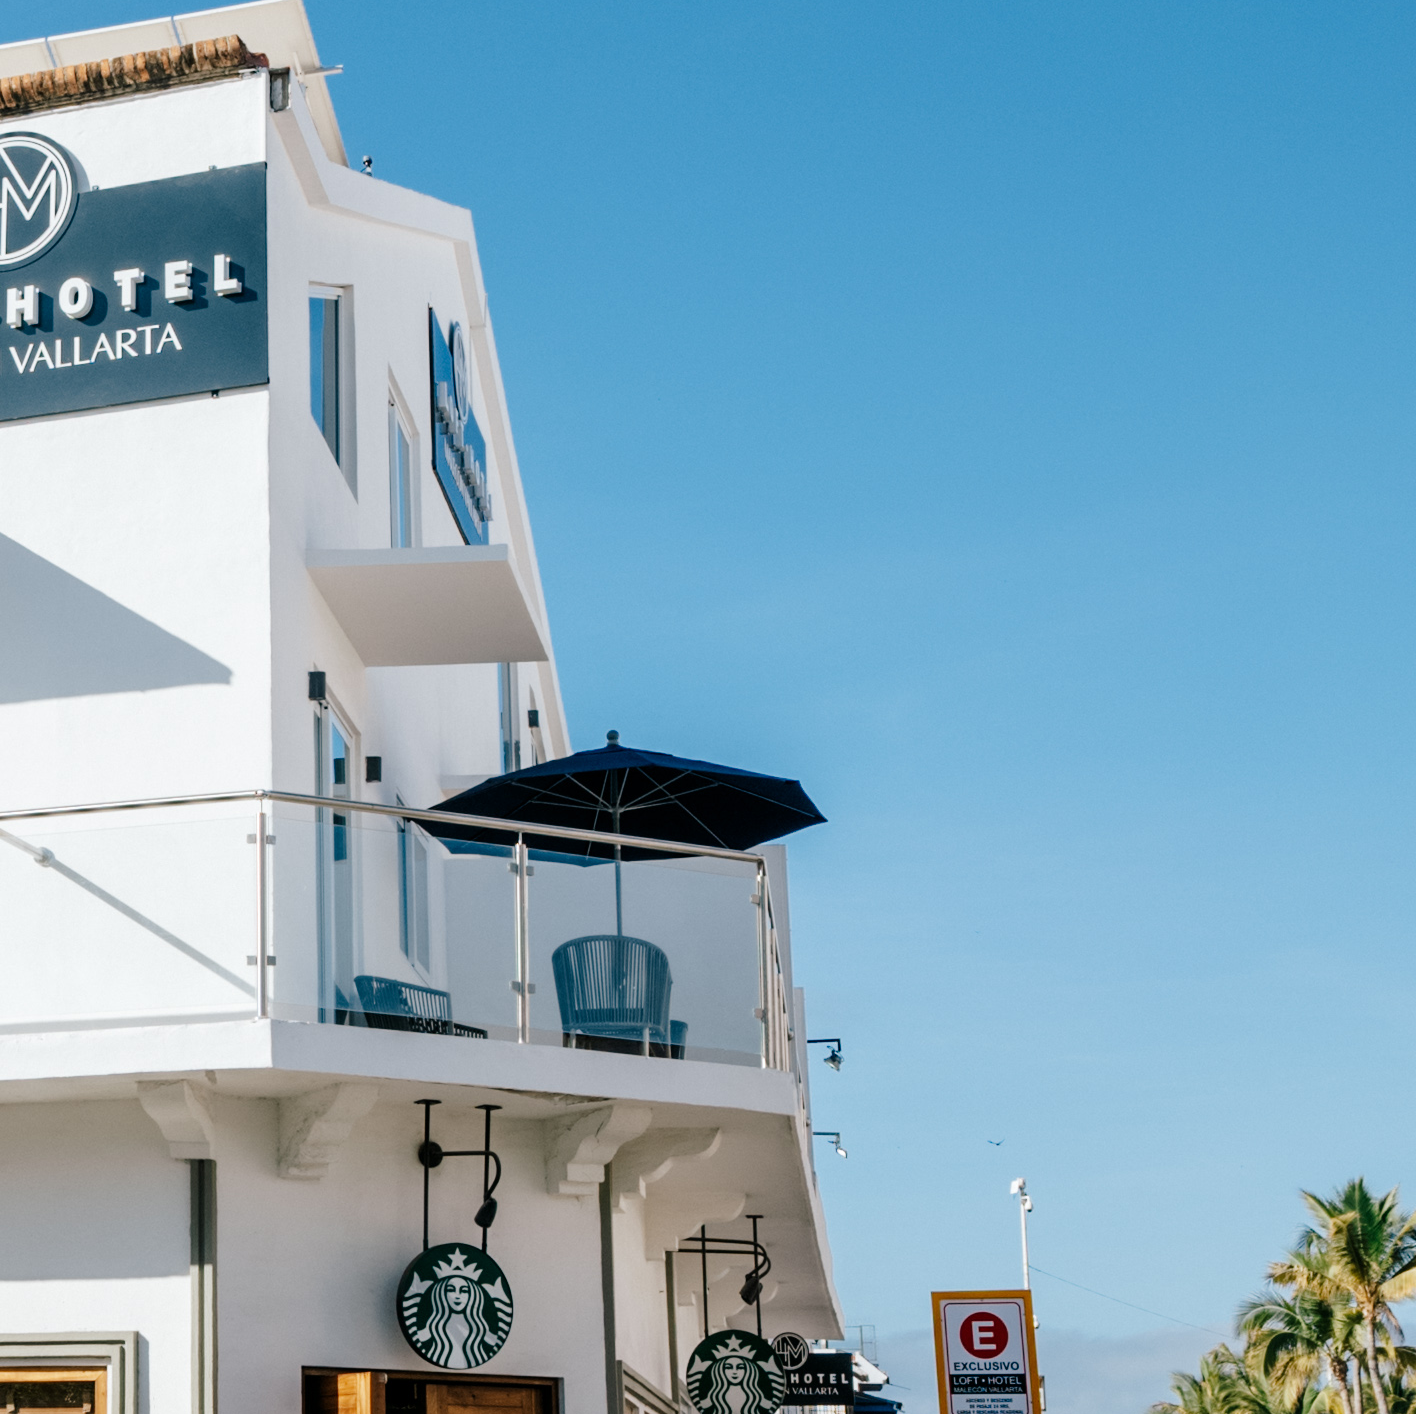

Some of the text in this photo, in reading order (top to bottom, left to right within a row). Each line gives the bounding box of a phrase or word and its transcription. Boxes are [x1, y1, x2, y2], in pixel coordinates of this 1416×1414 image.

[7, 254, 243, 328] HOTEL
[10, 322, 183, 374] VALLARTA
[971, 1320, 997, 1350] E
[953, 1361, 1020, 1371] EXCLUSIVO
[790, 1373, 849, 1384] HOTEL
[953, 1376, 1022, 1385] LOFT HOTEL
[792, 1387, 839, 1395] VALLARTA
